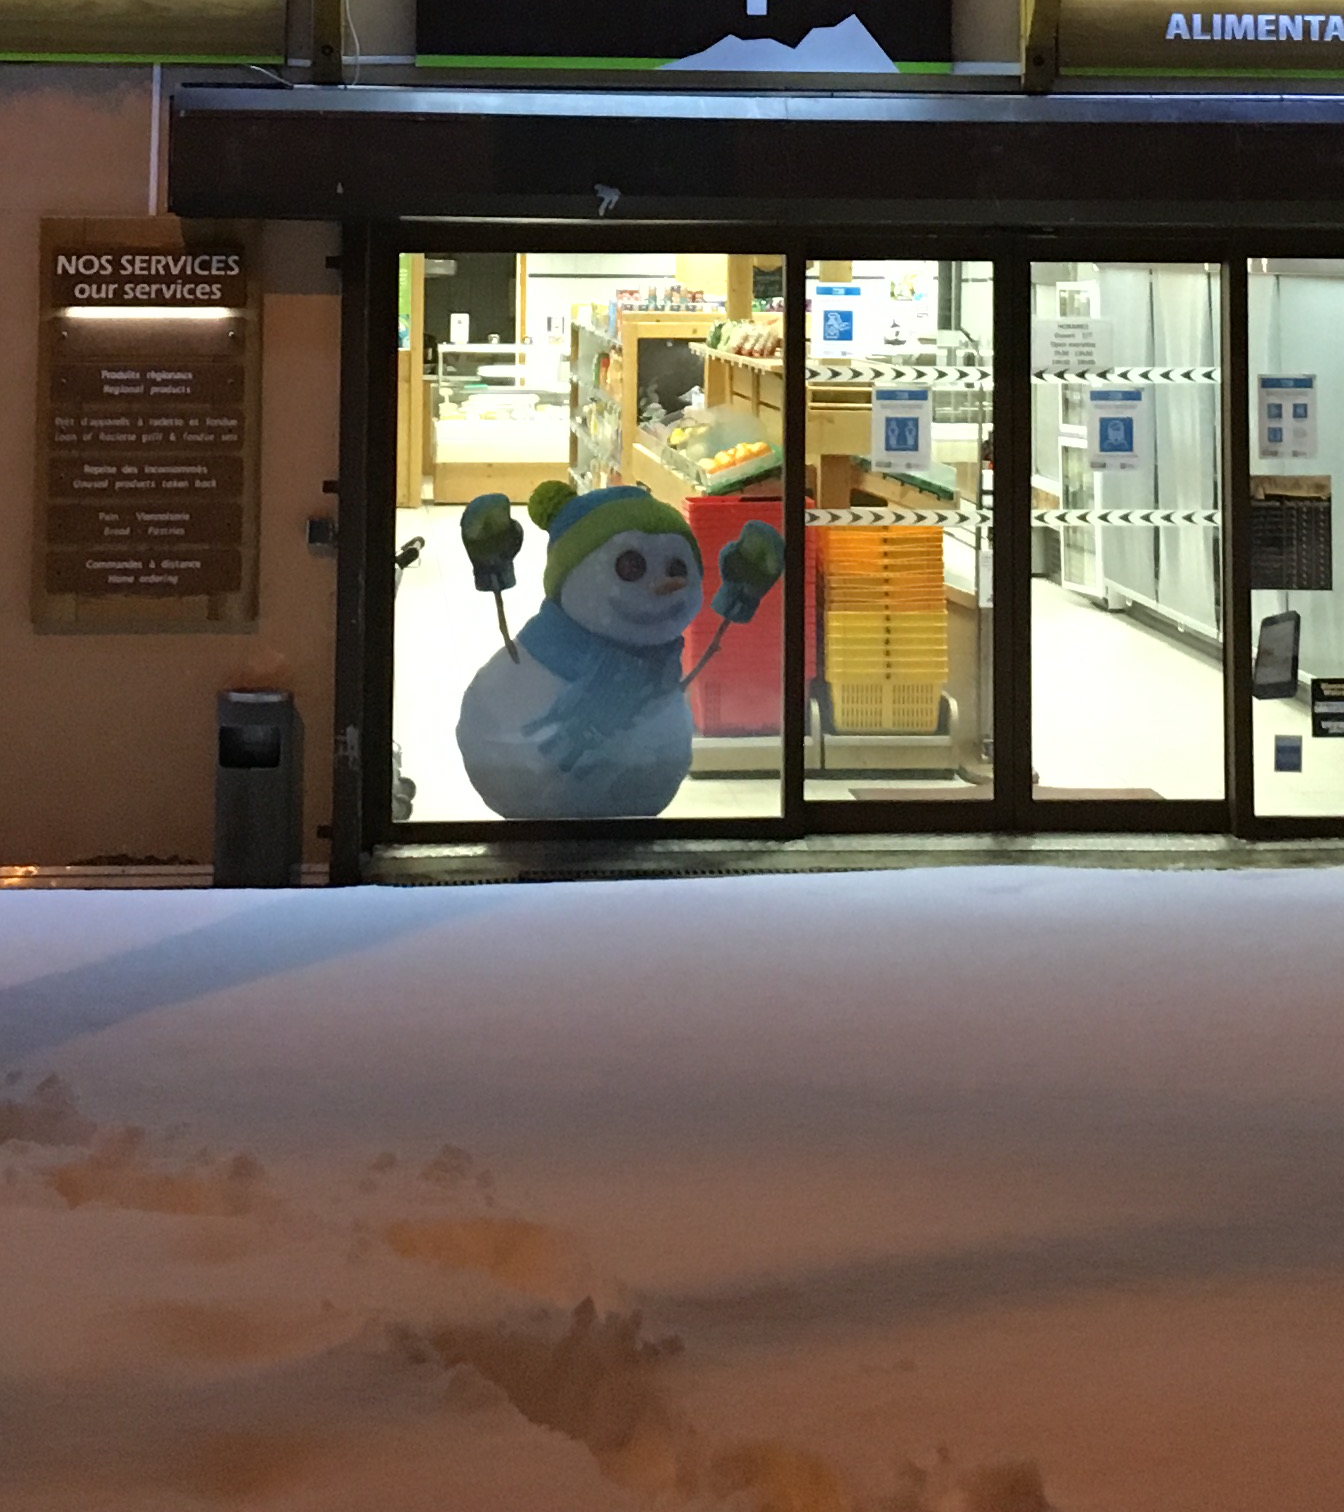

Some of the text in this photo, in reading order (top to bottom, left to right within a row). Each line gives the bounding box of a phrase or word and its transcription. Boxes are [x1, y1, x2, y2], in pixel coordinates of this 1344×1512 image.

[56, 255, 240, 275] NOS SERVICES
[74, 279, 222, 299] our services
[150, 385, 191, 395] products
